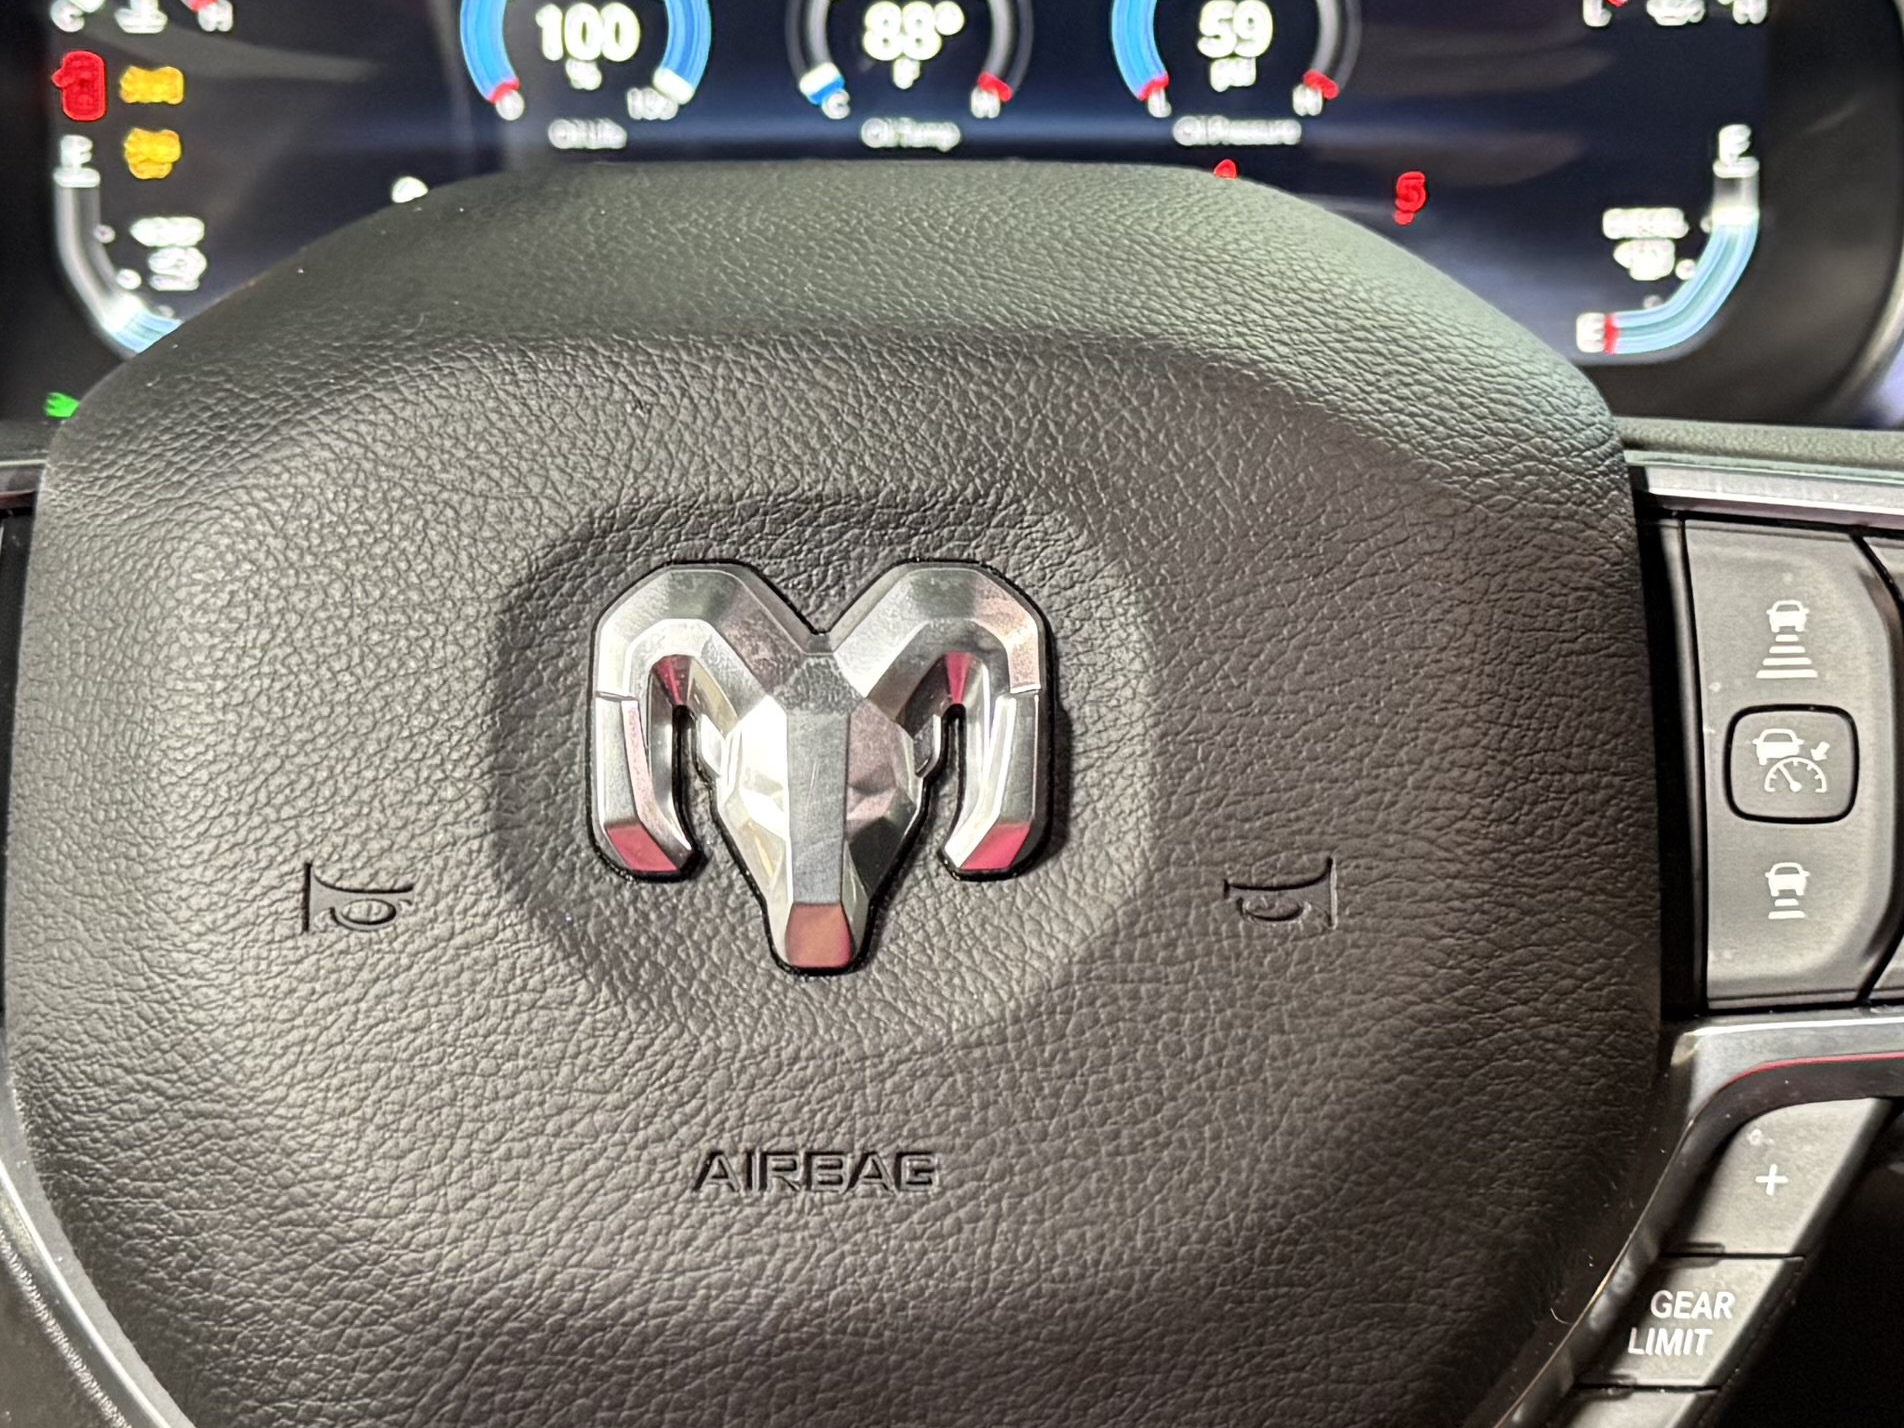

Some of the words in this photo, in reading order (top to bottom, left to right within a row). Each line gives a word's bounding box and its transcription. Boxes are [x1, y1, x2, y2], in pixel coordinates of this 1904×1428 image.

[535, 2, 641, 61] 100
[693, 1149, 944, 1194] AIRBAG
[1650, 1289, 1736, 1321] GEAR
[1627, 1326, 1714, 1357] LIMIT
